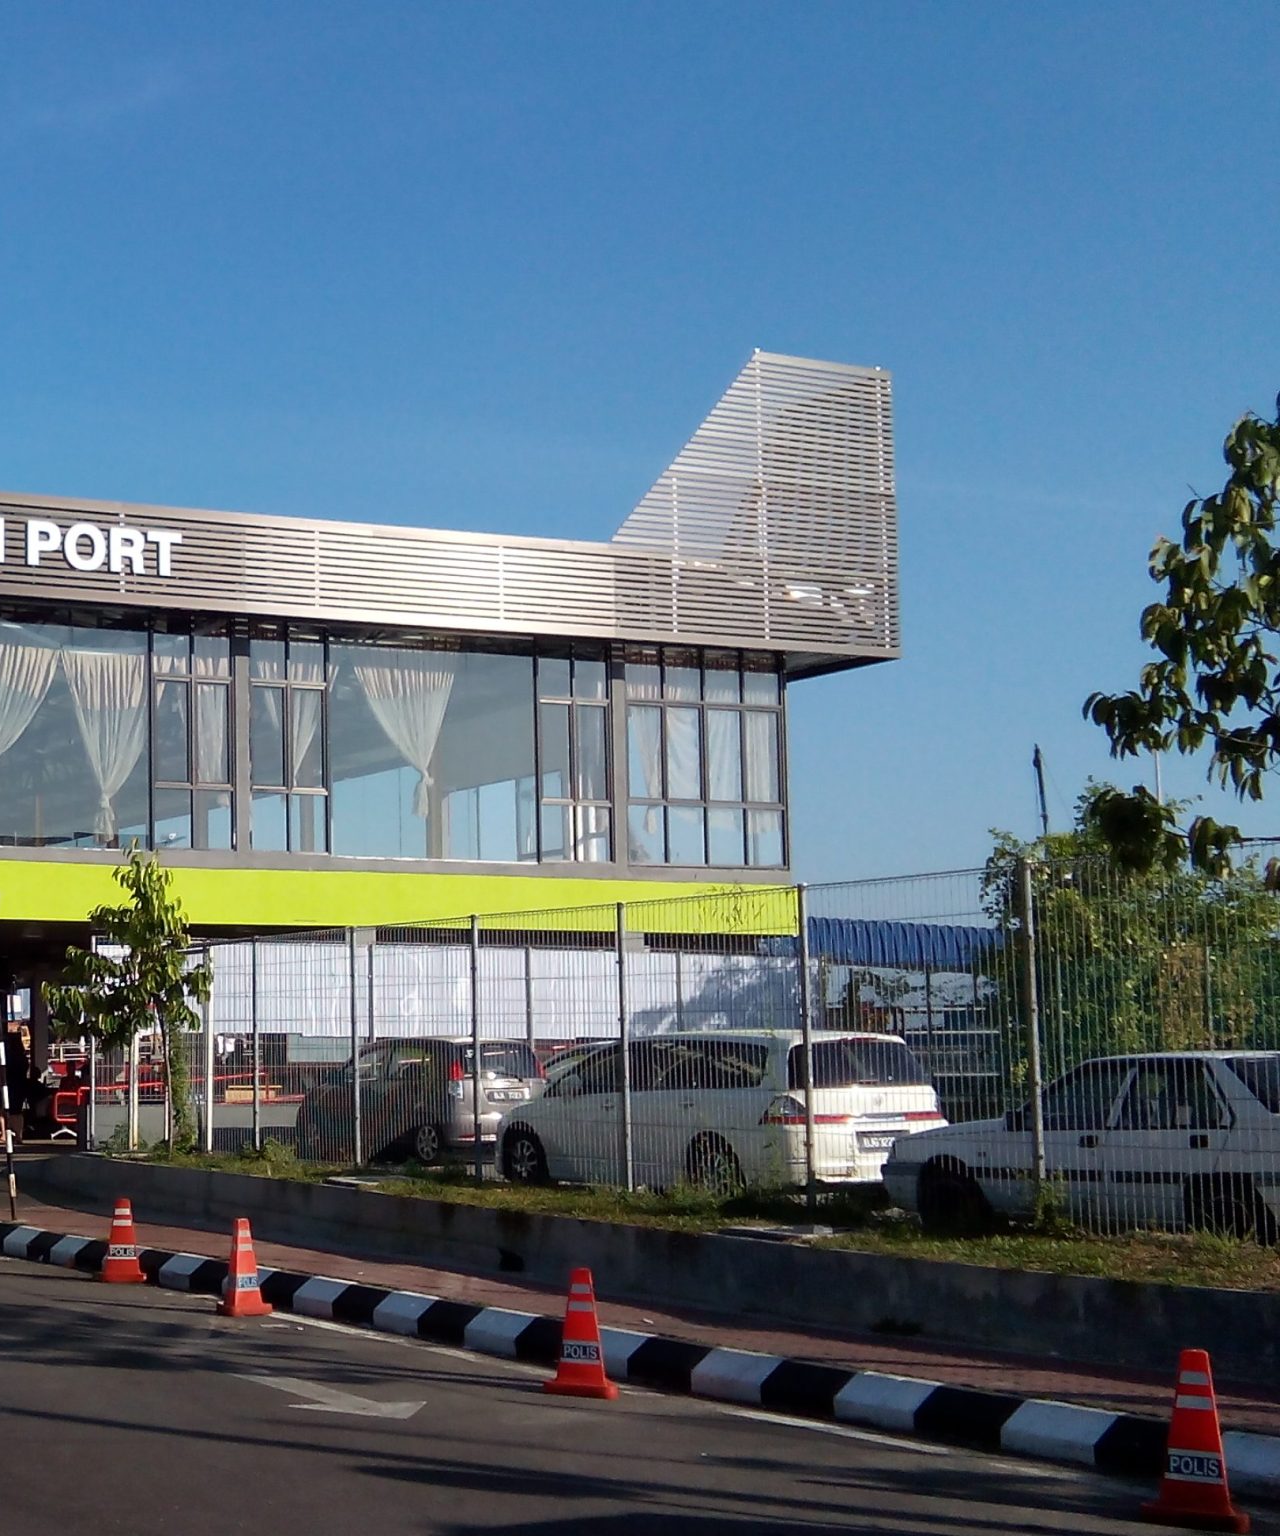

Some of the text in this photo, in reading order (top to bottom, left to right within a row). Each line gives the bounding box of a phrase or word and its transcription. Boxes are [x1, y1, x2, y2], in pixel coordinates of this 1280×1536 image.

[26, 520, 183, 577] PORT
[110, 1247, 135, 1257] POLIS
[237, 1276, 257, 1288] POLIS
[563, 1345, 597, 1359] POLIS
[1169, 1455, 1219, 1477] POLIS
